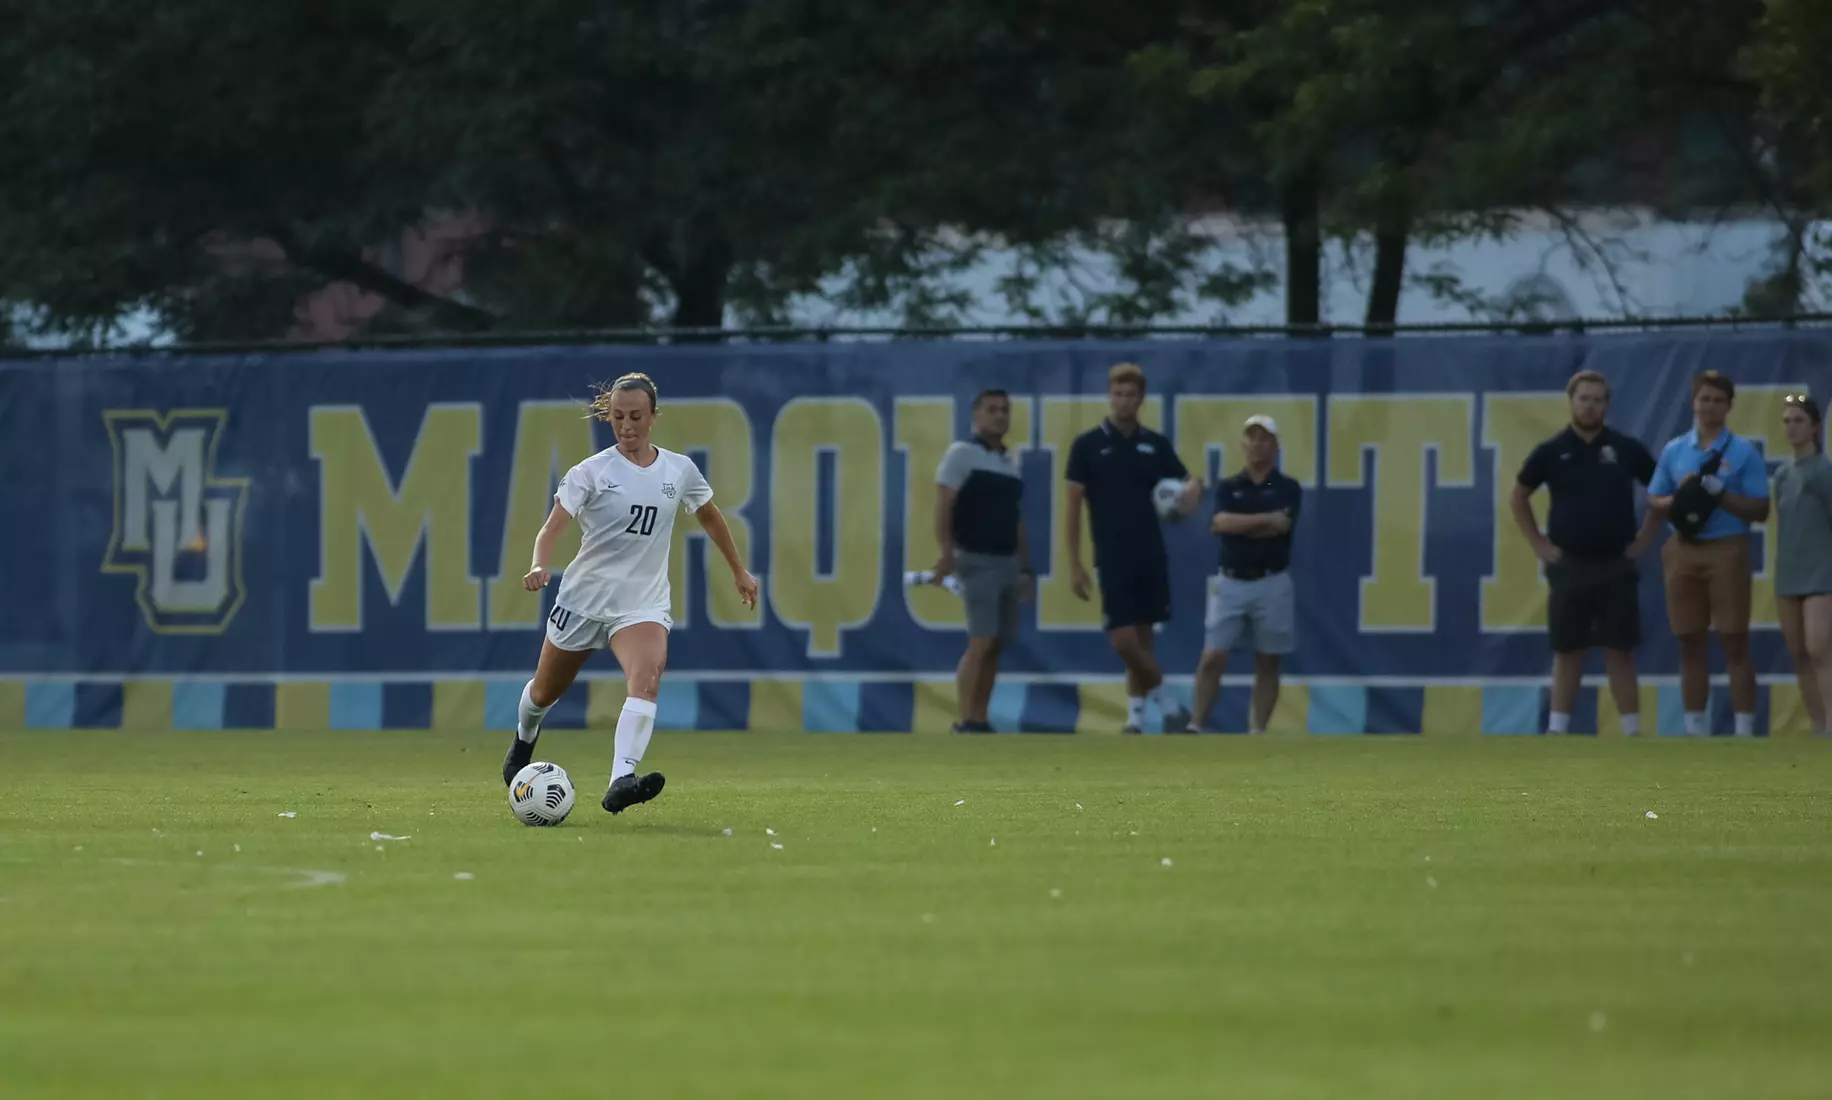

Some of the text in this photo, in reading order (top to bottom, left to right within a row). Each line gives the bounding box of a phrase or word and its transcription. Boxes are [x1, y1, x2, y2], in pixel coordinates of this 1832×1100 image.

[121, 415, 233, 614] MU
[625, 504, 658, 536] 20
[550, 605, 571, 631] 20
